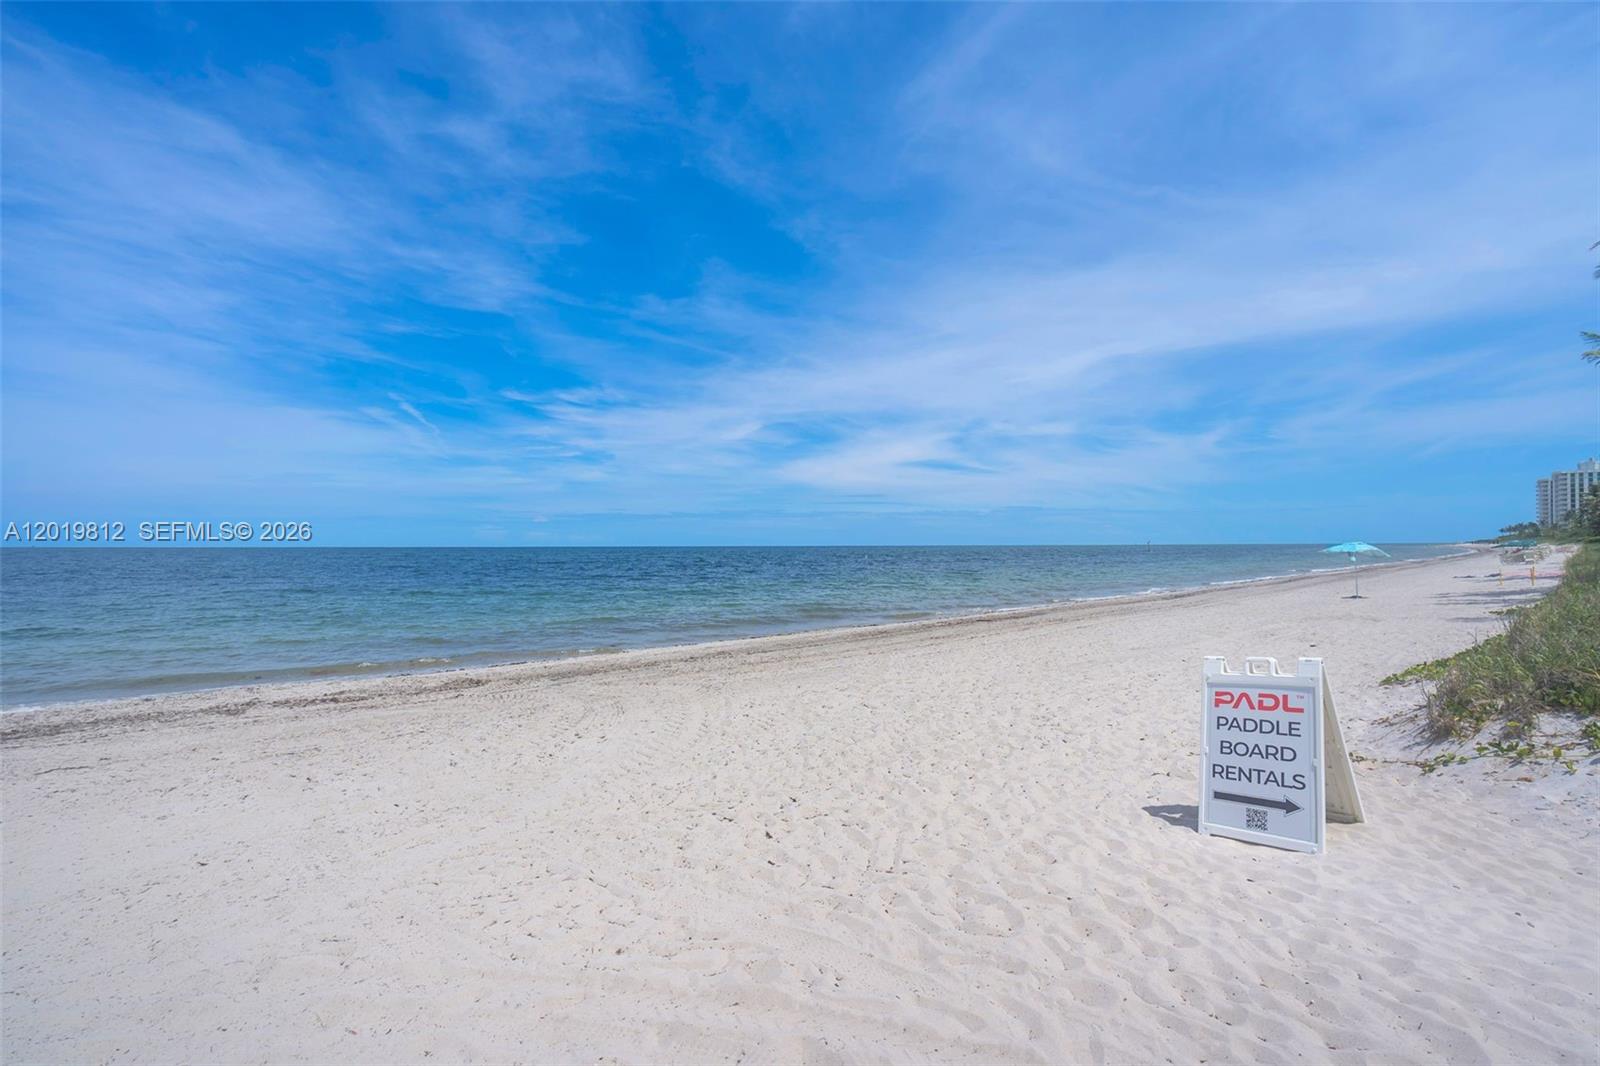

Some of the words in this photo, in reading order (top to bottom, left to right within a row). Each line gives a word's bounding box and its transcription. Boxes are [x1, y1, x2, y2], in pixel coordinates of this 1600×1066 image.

[1214, 691, 1304, 713] PADL
[1216, 716, 1302, 737] PADDLE
[1220, 740, 1297, 762] BOARD
[1212, 764, 1306, 790] RENTALS
